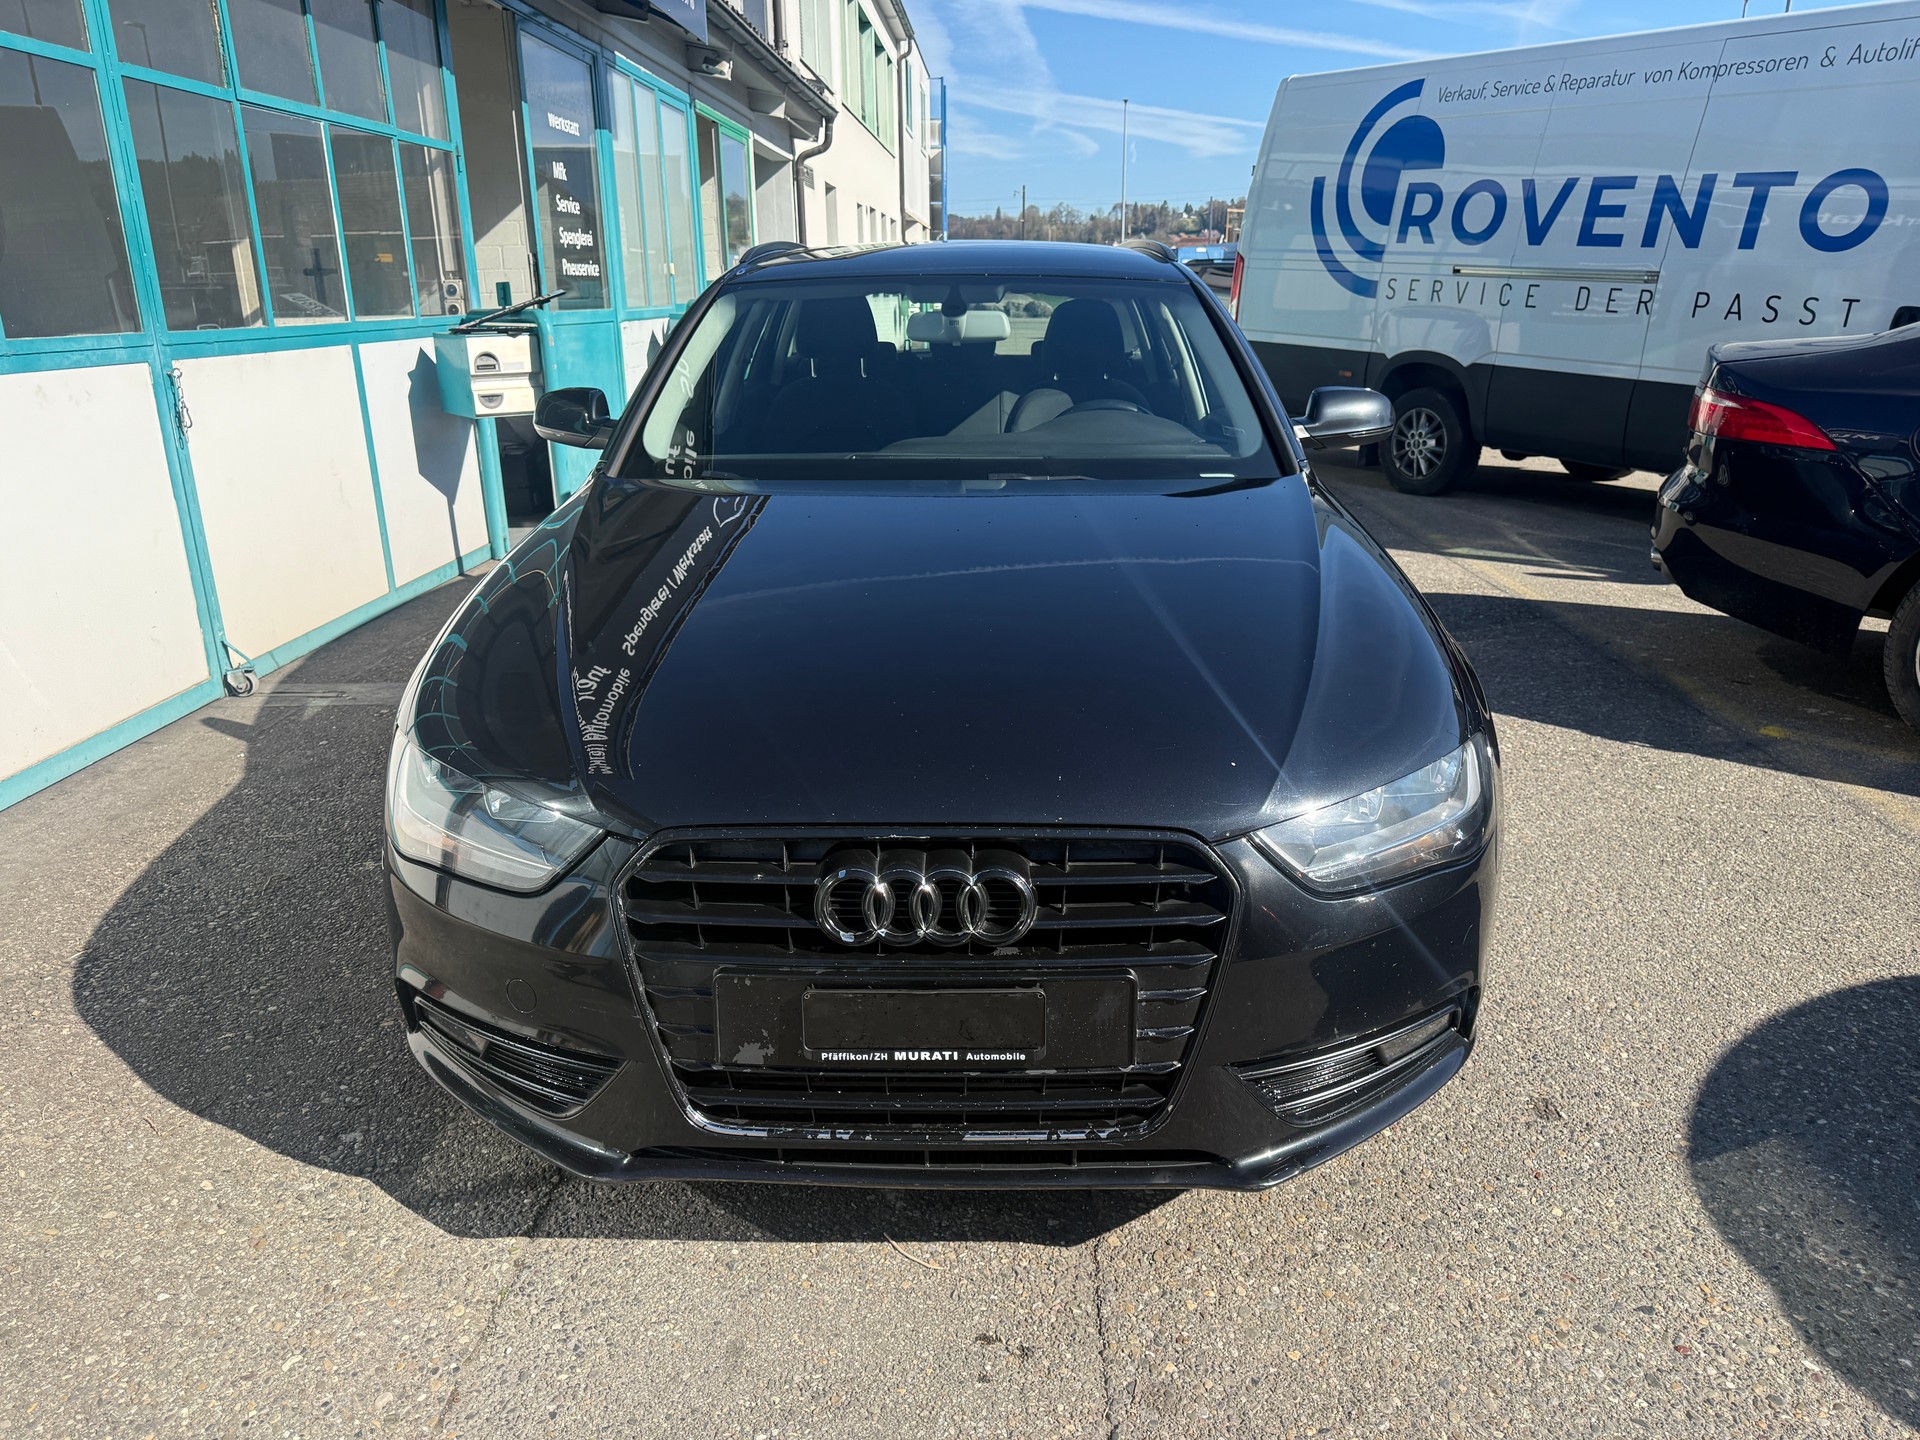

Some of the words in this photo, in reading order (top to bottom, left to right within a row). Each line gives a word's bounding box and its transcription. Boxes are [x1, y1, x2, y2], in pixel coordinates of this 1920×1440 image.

[1491, 78, 1539, 98] Service
[1543, 74, 1556, 93] &
[1559, 69, 1636, 94] Reparatur
[1643, 68, 1673, 84] von
[1677, 55, 1809, 83] Kompressoren
[1820, 45, 1837, 67] &
[547, 112, 580, 136] Werkstatt
[555, 194, 581, 214] Service
[559, 226, 593, 249] Spenglerei
[561, 258, 600, 276] Pneuservice
[1385, 278, 1540, 308] SERVICE
[1574, 286, 1654, 315] DER
[1691, 291, 1861, 328] PASST
[821, 1052, 888, 1061] Pfäffikon/ZH
[894, 1051, 958, 1061] MURATI
[966, 1052, 1026, 1061] Automobile
